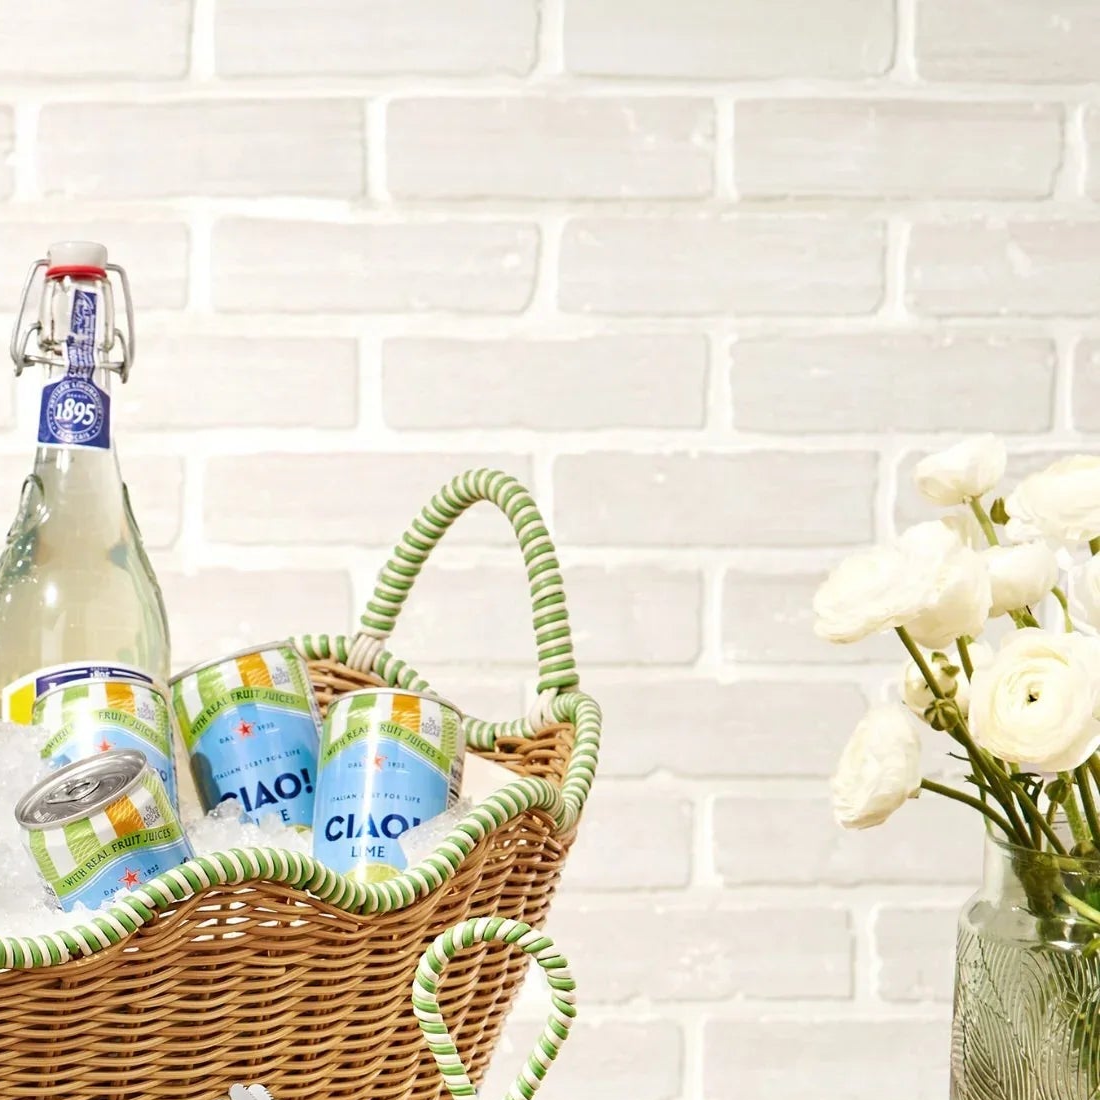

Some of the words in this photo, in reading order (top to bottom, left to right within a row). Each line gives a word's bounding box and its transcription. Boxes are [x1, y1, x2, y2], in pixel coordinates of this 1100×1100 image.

[55, 397, 95, 426] 1895
[98, 710, 128, 723] FRUIT
[206, 697, 228, 718] REAL
[230, 689, 261, 702] FRUIT
[262, 691, 296, 705] JUICES
[326, 739, 346, 757] WITH
[379, 722, 405, 737] RUIT
[404, 733, 437, 758] JUICES
[64, 867, 88, 887] WITH
[85, 850, 111, 870] REAL
[111, 834, 141, 853] FRUIT
[143, 827, 172, 843] JUICES
